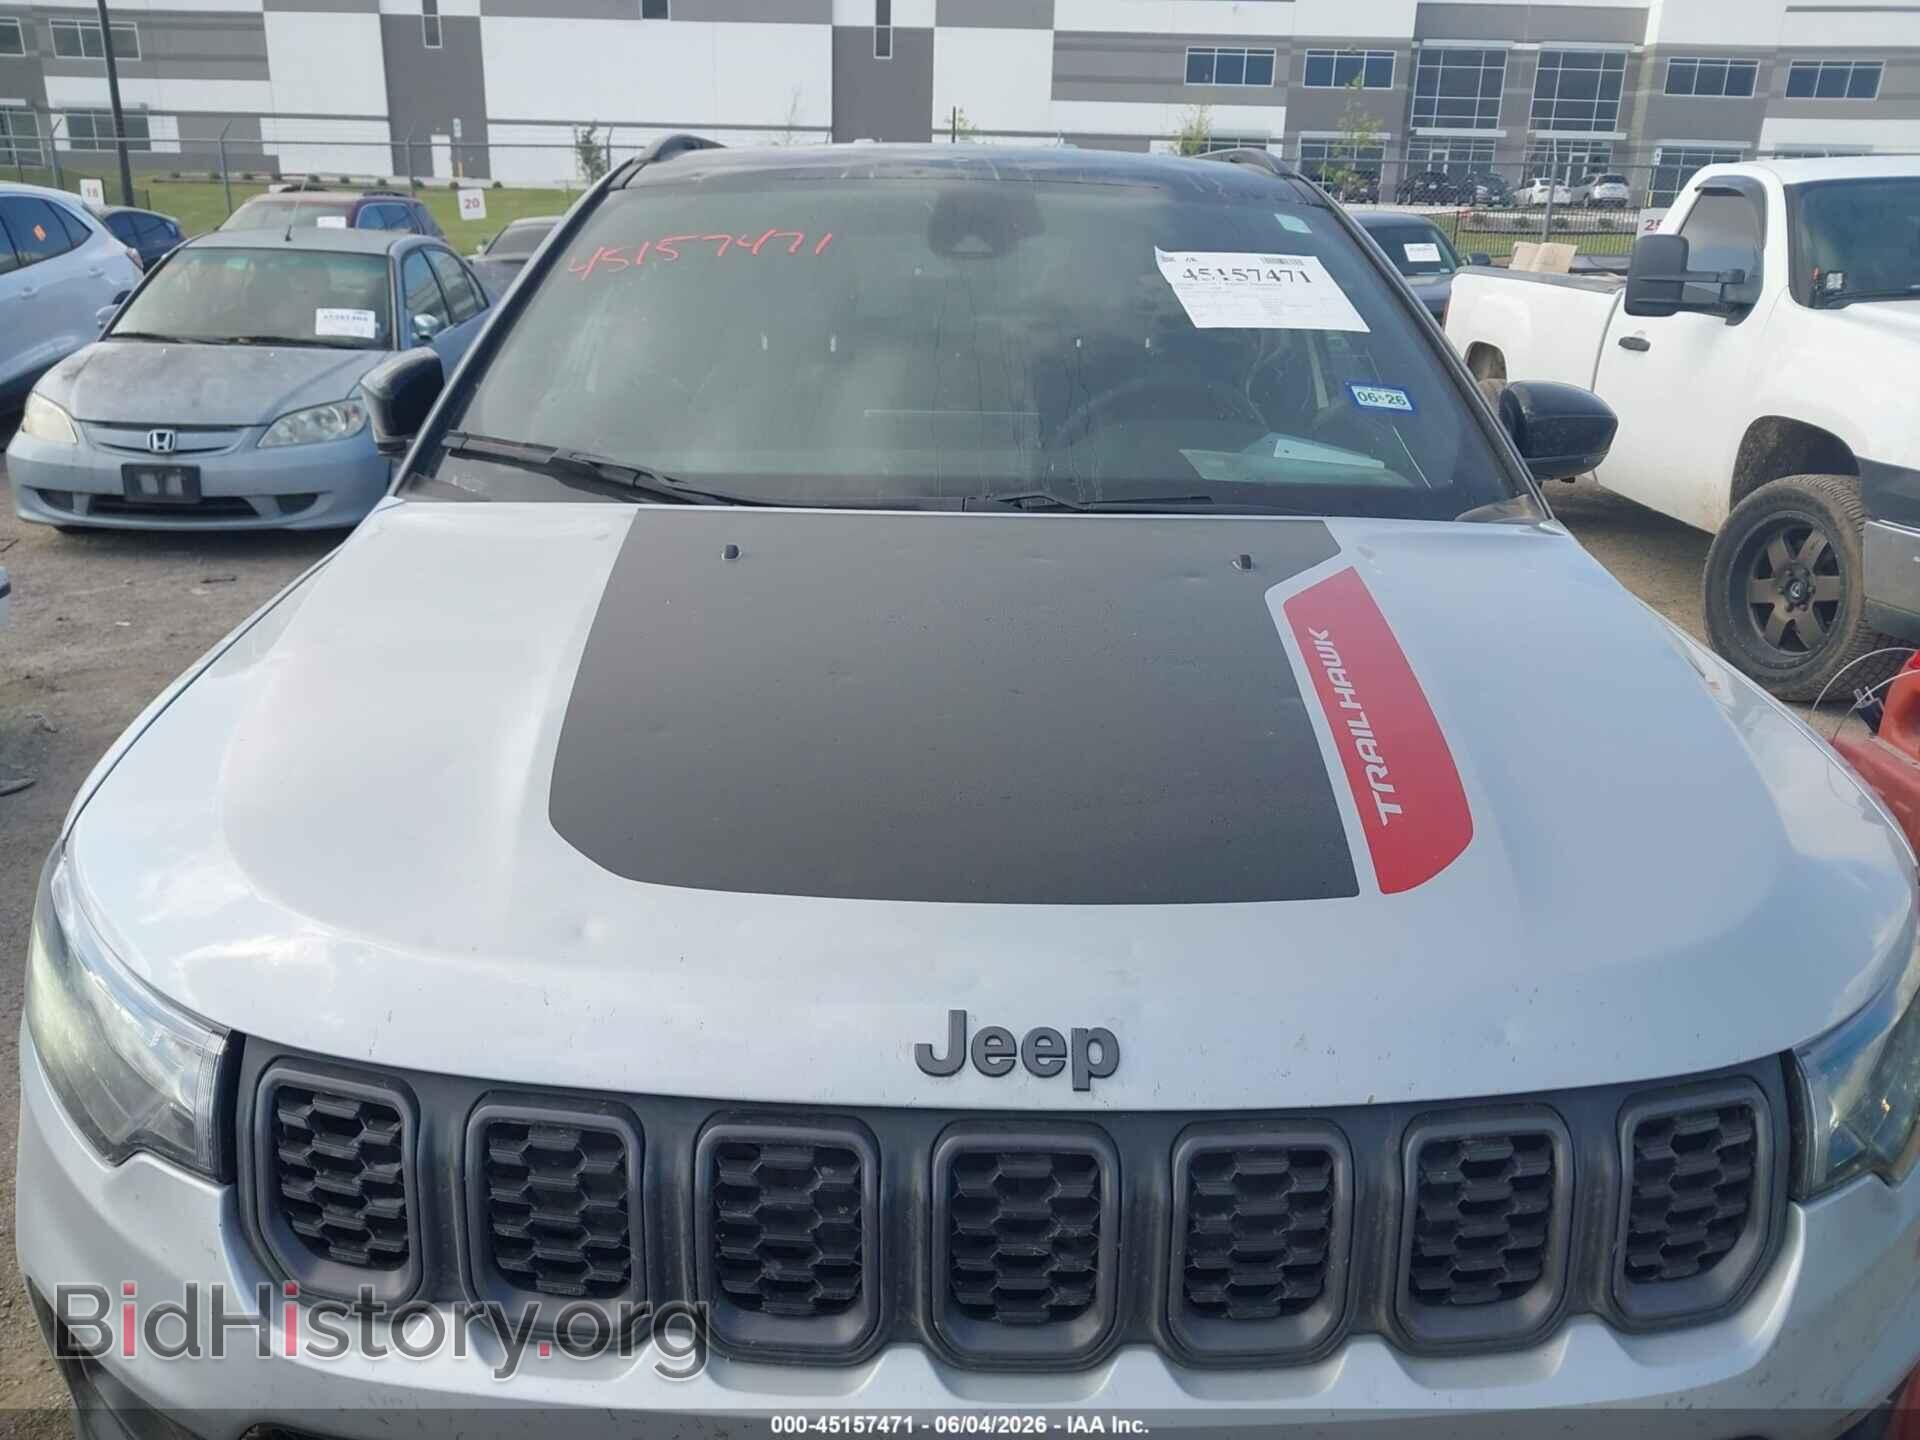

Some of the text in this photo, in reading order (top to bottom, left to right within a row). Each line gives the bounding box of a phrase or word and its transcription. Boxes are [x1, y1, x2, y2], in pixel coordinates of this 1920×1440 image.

[464, 198, 481, 210] 20
[568, 229, 833, 281] 45157471
[1182, 268, 1312, 283] 45157471
[1308, 627, 1403, 827] TRAILHAWK
[914, 1010, 1120, 1092] Jeep
